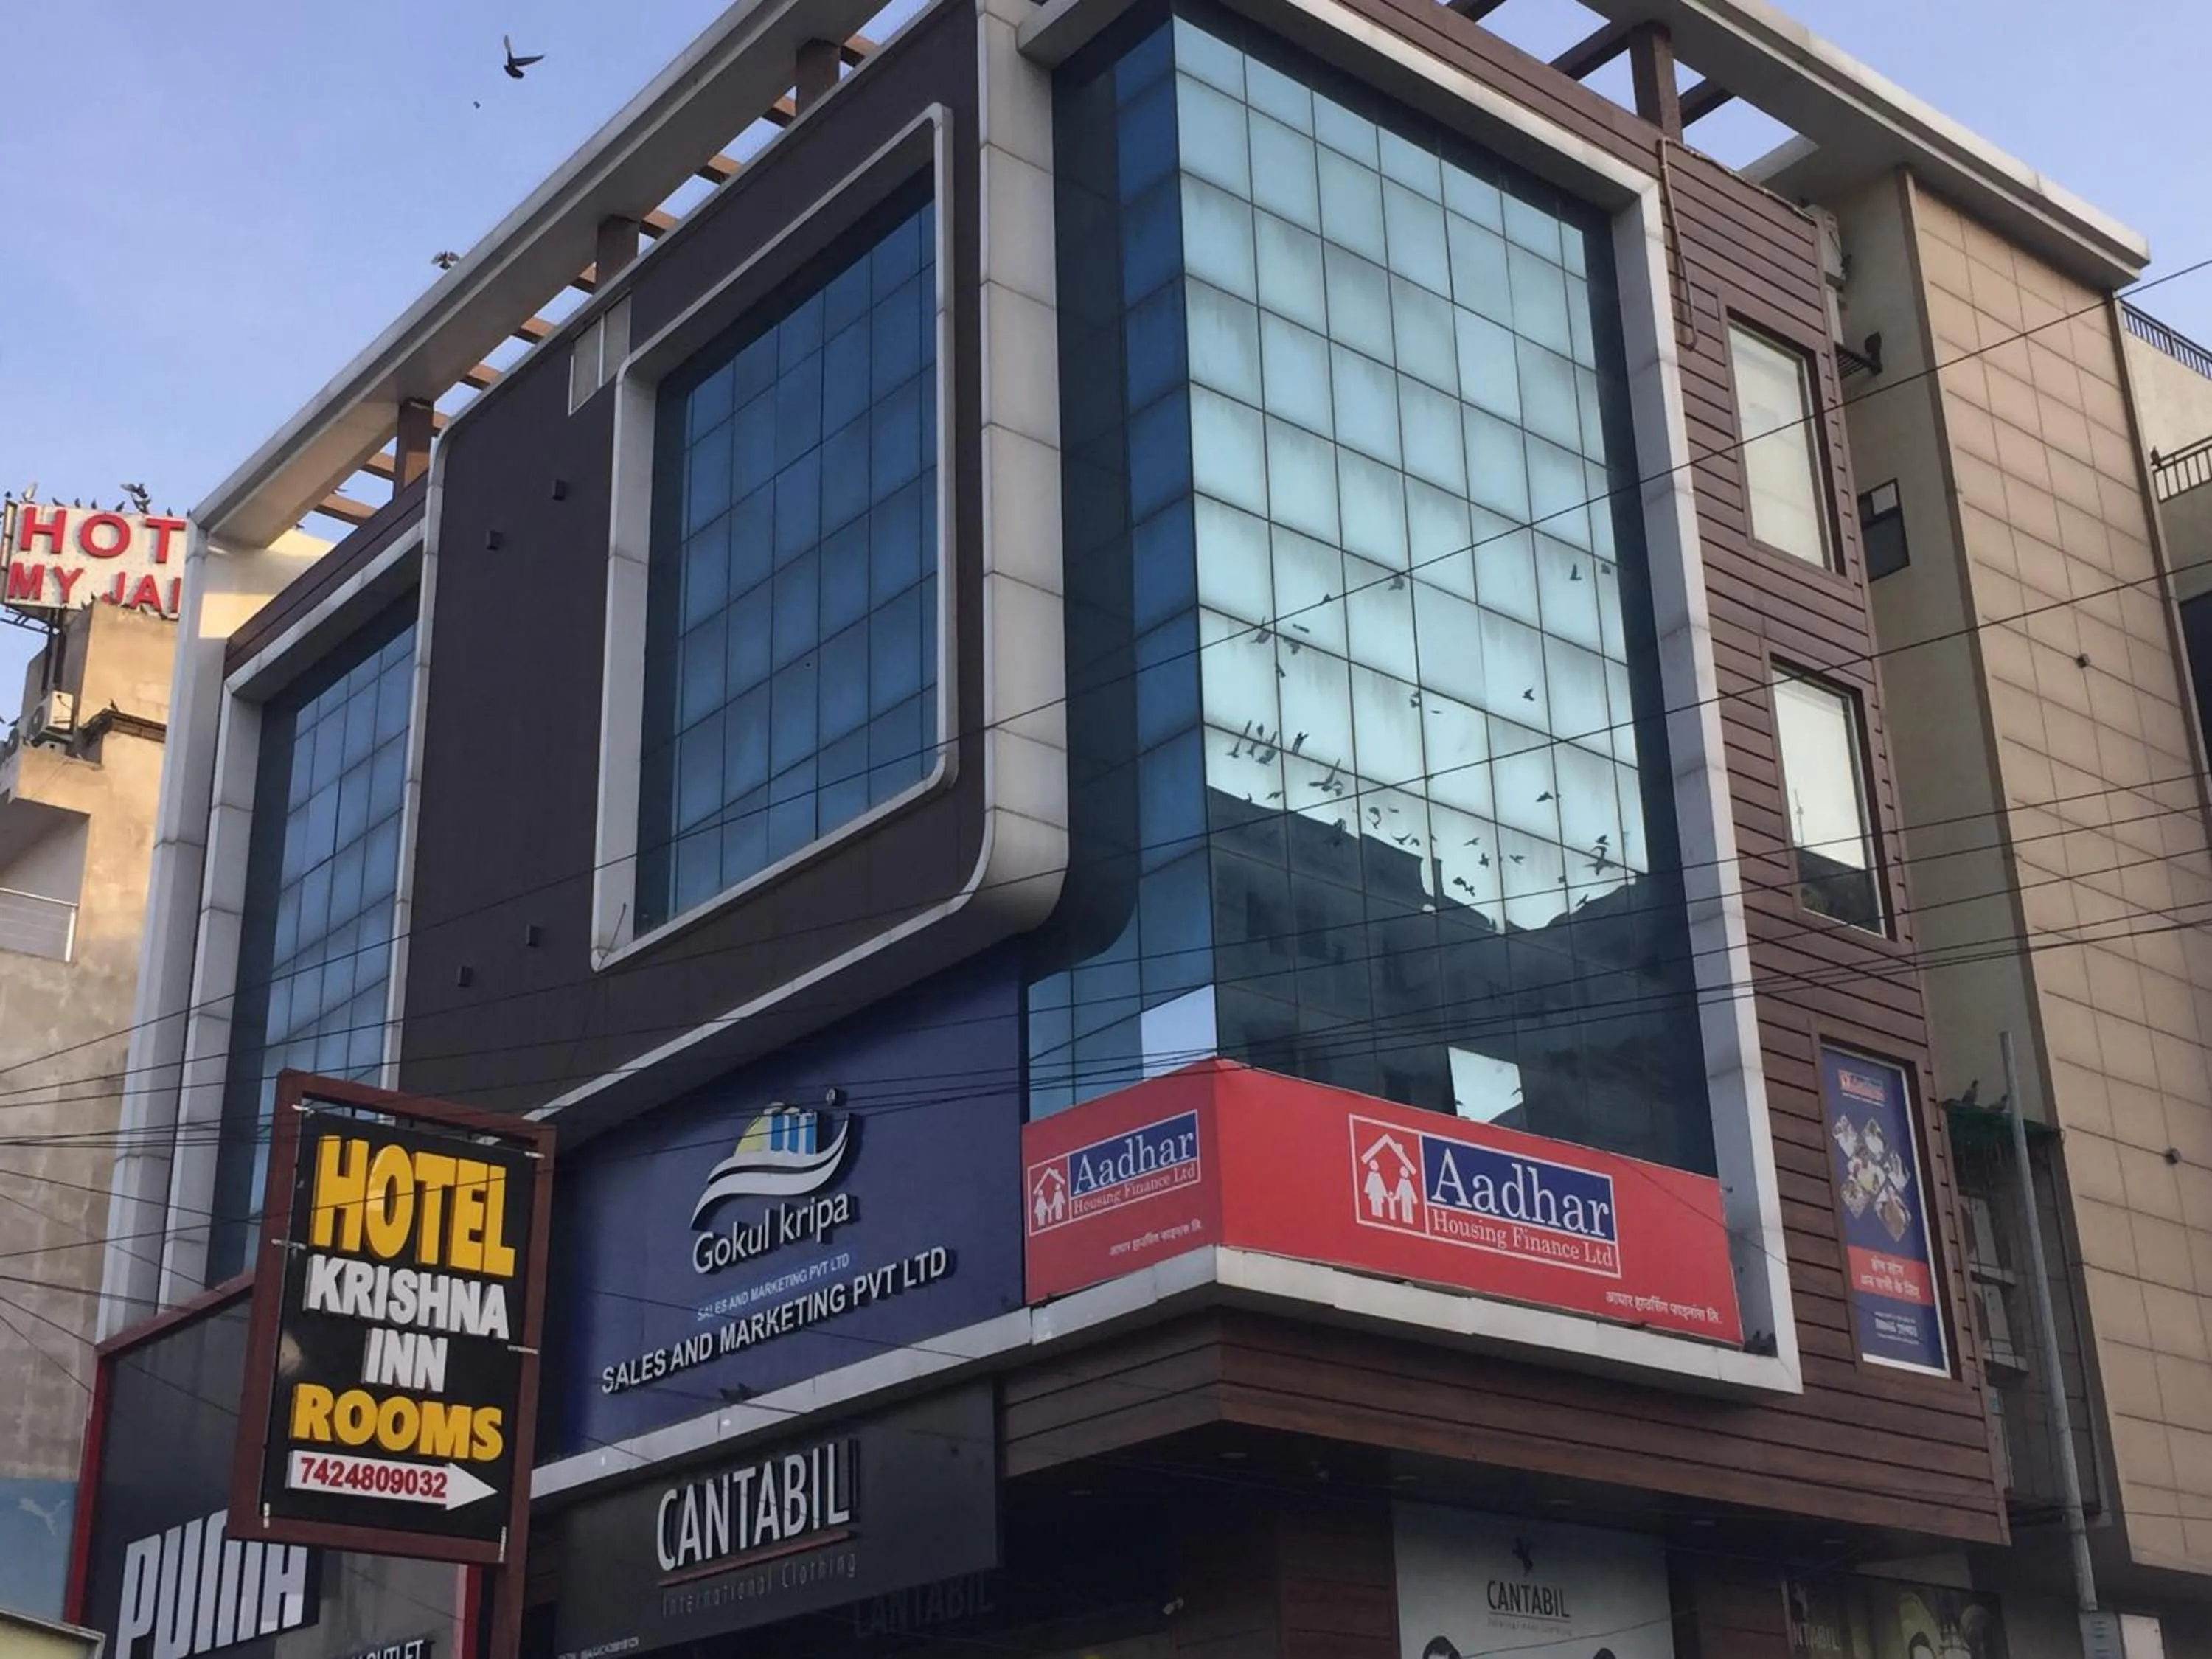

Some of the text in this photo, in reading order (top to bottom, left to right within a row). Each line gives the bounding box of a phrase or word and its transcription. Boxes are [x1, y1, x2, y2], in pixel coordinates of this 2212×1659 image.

[19, 506, 187, 564] HOT
[7, 562, 84, 604] MY
[1073, 1132, 1194, 1195] Aadhar
[1074, 1164, 1196, 1214] Housing Finance Ltd
[1431, 1147, 1610, 1237] Aadhar
[308, 1135, 515, 1276] HOTEL
[692, 1192, 850, 1274] Gokul kripa
[1432, 1210, 1614, 1267] Housing Finance Ltd
[304, 1254, 509, 1340] KRISHNA
[697, 1253, 850, 1321] SALES AND MARKETING PVT LTD
[601, 1246, 947, 1395] SALES AND MARKETING PVT LTD
[362, 1327, 448, 1392] INN
[290, 1383, 503, 1461] ROOMS
[300, 1457, 447, 1498] 7424809032
[656, 1443, 851, 1571] CANTABIL
[114, 1509, 308, 1659] PUMA
[781, 1553, 856, 1589] Clothing
[1486, 1579, 1571, 1618] CANTABIL
[366, 1639, 425, 1659] TLET
